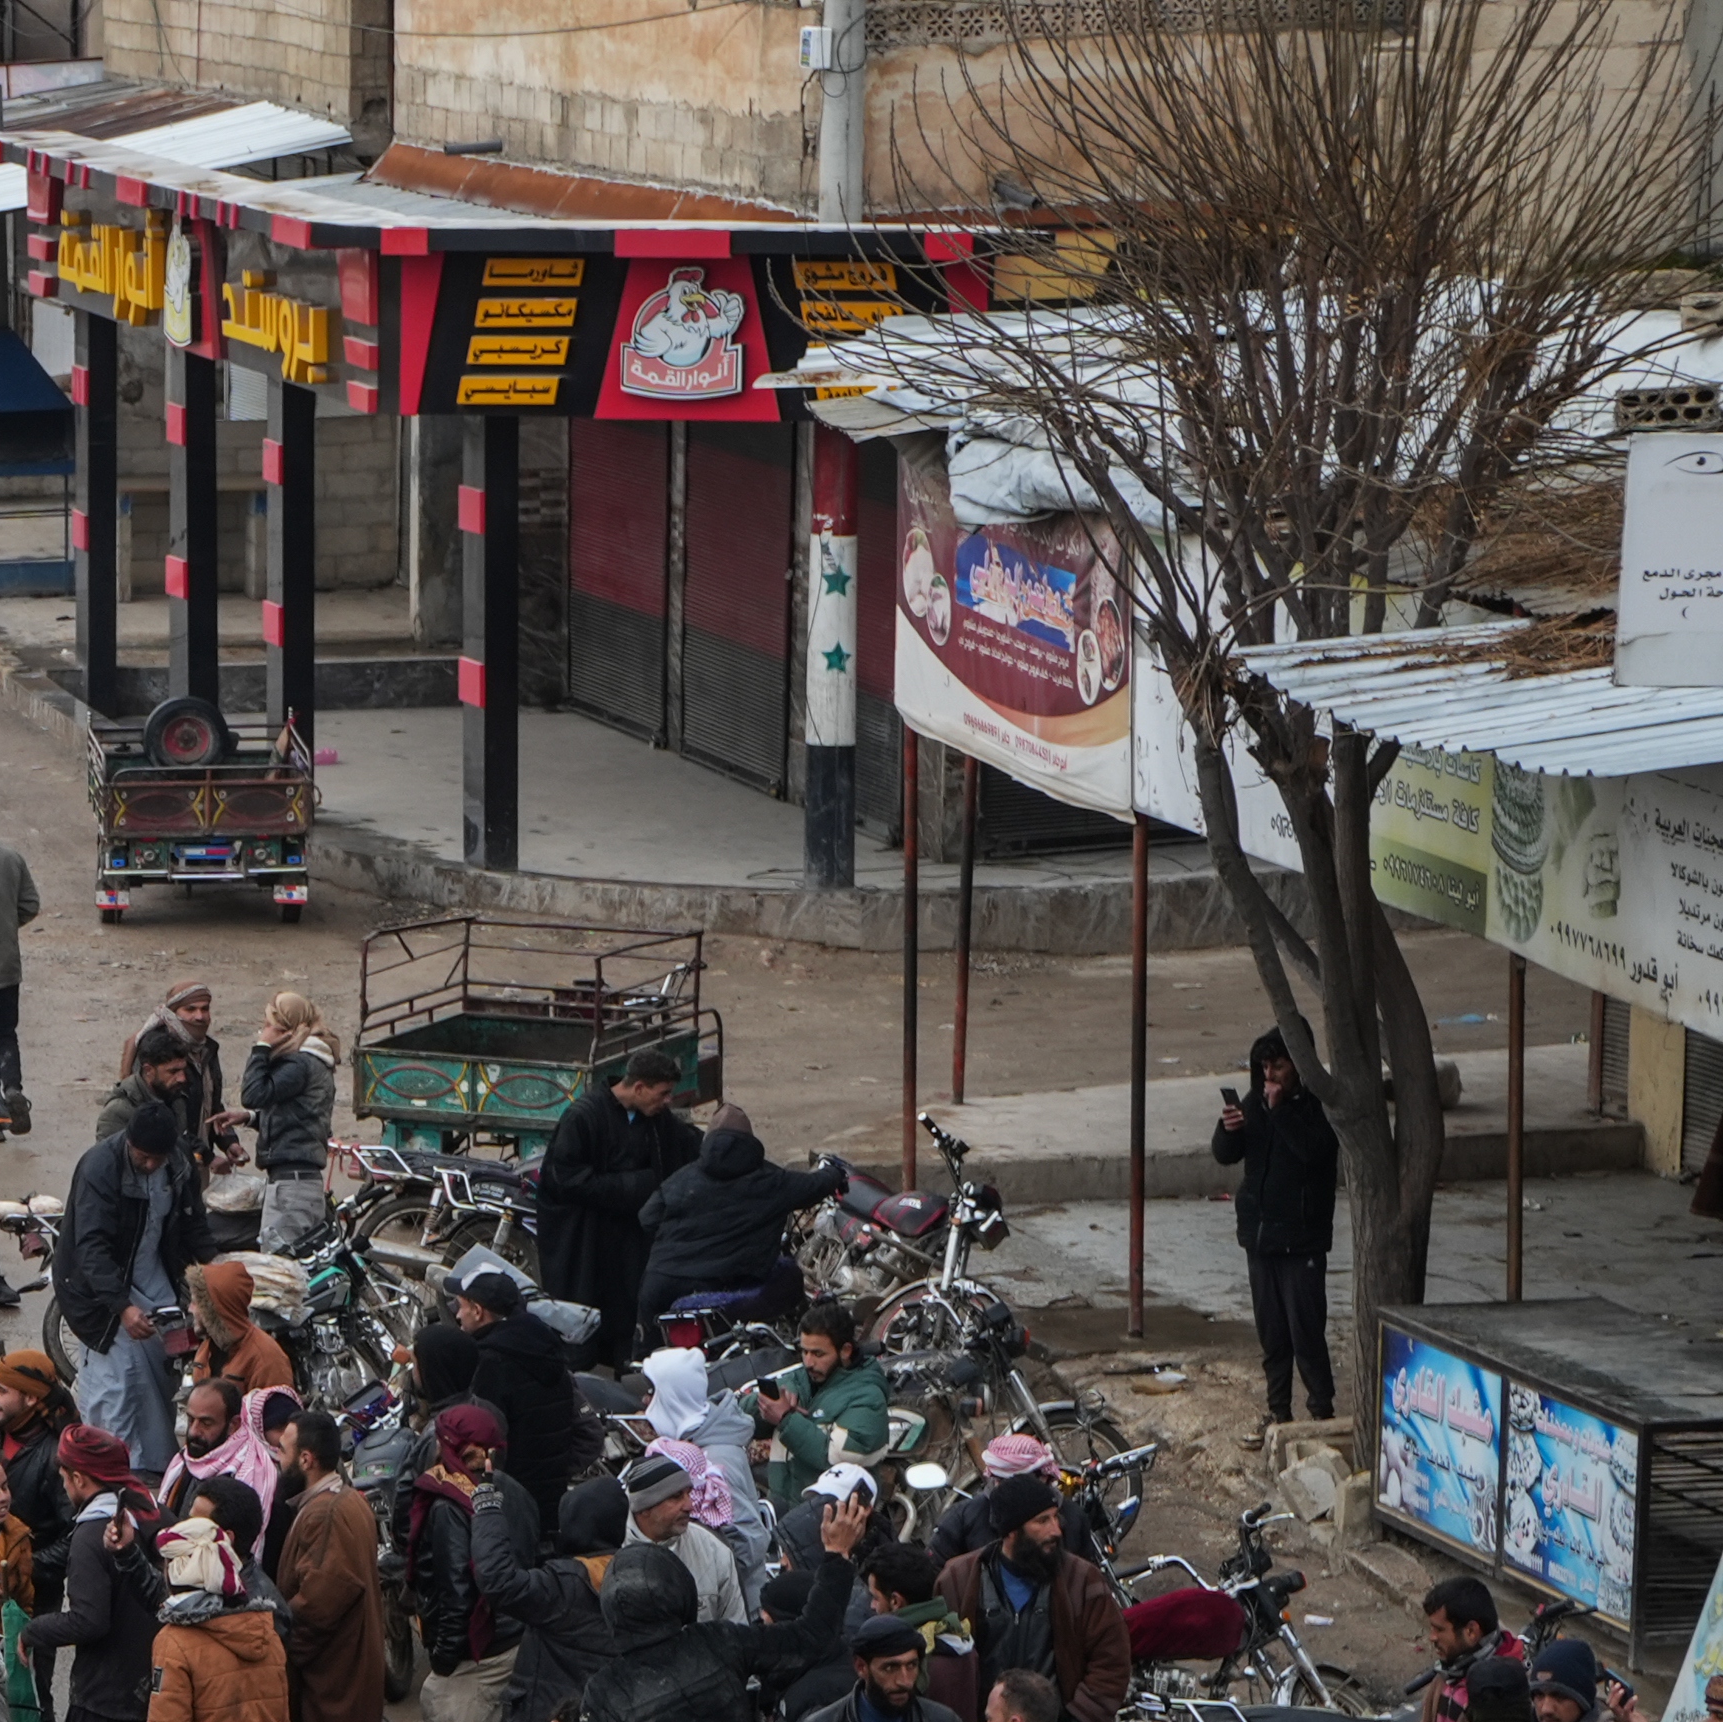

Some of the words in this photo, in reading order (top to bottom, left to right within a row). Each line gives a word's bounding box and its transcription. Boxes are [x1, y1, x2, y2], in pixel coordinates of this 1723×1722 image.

[57, 208, 121, 294] القمة
[112, 208, 166, 328] أنوار
[487, 260, 580, 283] شاورما
[221, 268, 329, 385] بروستد
[480, 302, 574, 323] مكسيكانو
[472, 339, 564, 363] كريسبي
[630, 358, 686, 388] القمة
[685, 354, 732, 391] أنوار
[464, 380, 552, 402] سبايسي
[1641, 568, 1681, 583] الدمع
[1659, 586, 1703, 602] الحول
[1395, 779, 1449, 823] مستلزمات
[1452, 799, 1480, 835] كافة
[1653, 807, 1690, 846] العربية
[1629, 957, 1659, 984] قدور
[1391, 1364, 1448, 1426] القادري
[1447, 1388, 1495, 1448] مشبك
[1541, 1462, 1604, 1526] القادري
